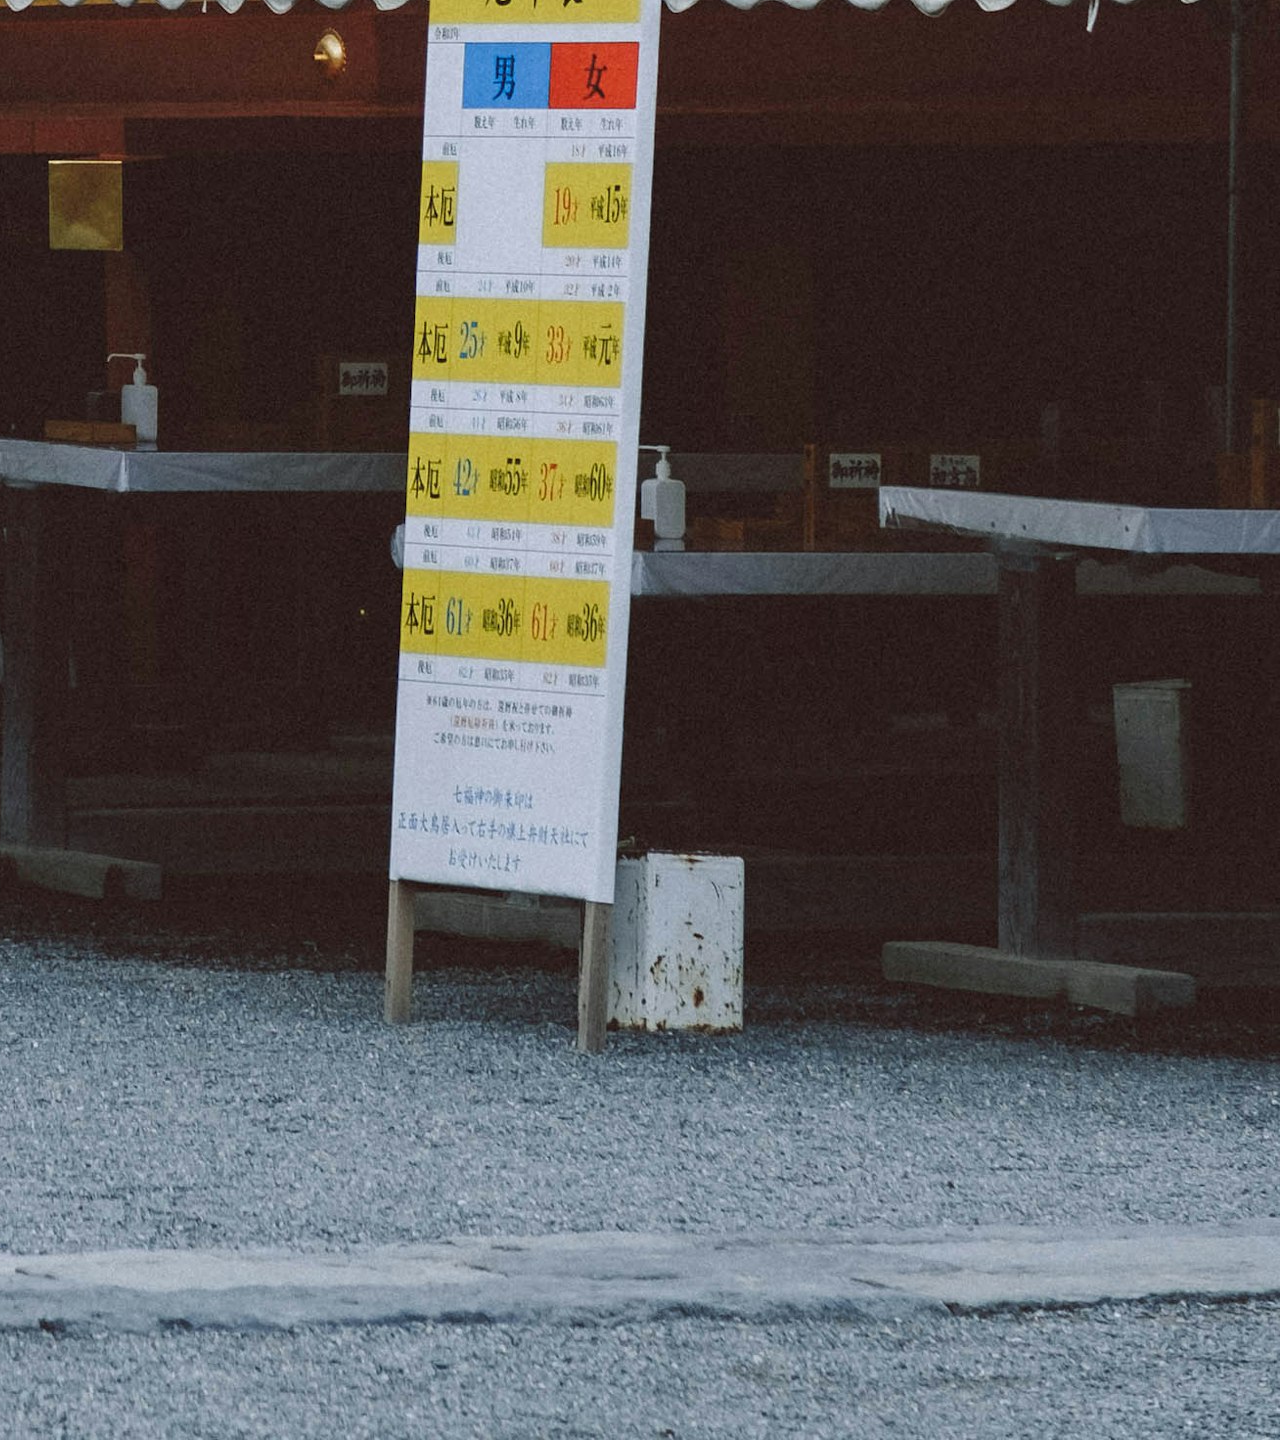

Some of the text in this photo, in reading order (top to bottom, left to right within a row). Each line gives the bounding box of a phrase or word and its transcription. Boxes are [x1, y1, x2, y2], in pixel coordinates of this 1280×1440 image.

[492, 53, 608, 101] 男 女
[424, 184, 628, 227] 本厄 19才 平成15年
[417, 320, 620, 366] 本厄 25才 平成9年 33才 平成元年
[410, 456, 614, 502] 本厄 42才 昭和55年 37才 昭和60年
[405, 592, 606, 642] 本厄 61才 昭和36年 61才 昭和36年
[448, 848, 521, 872] お受けいたします
